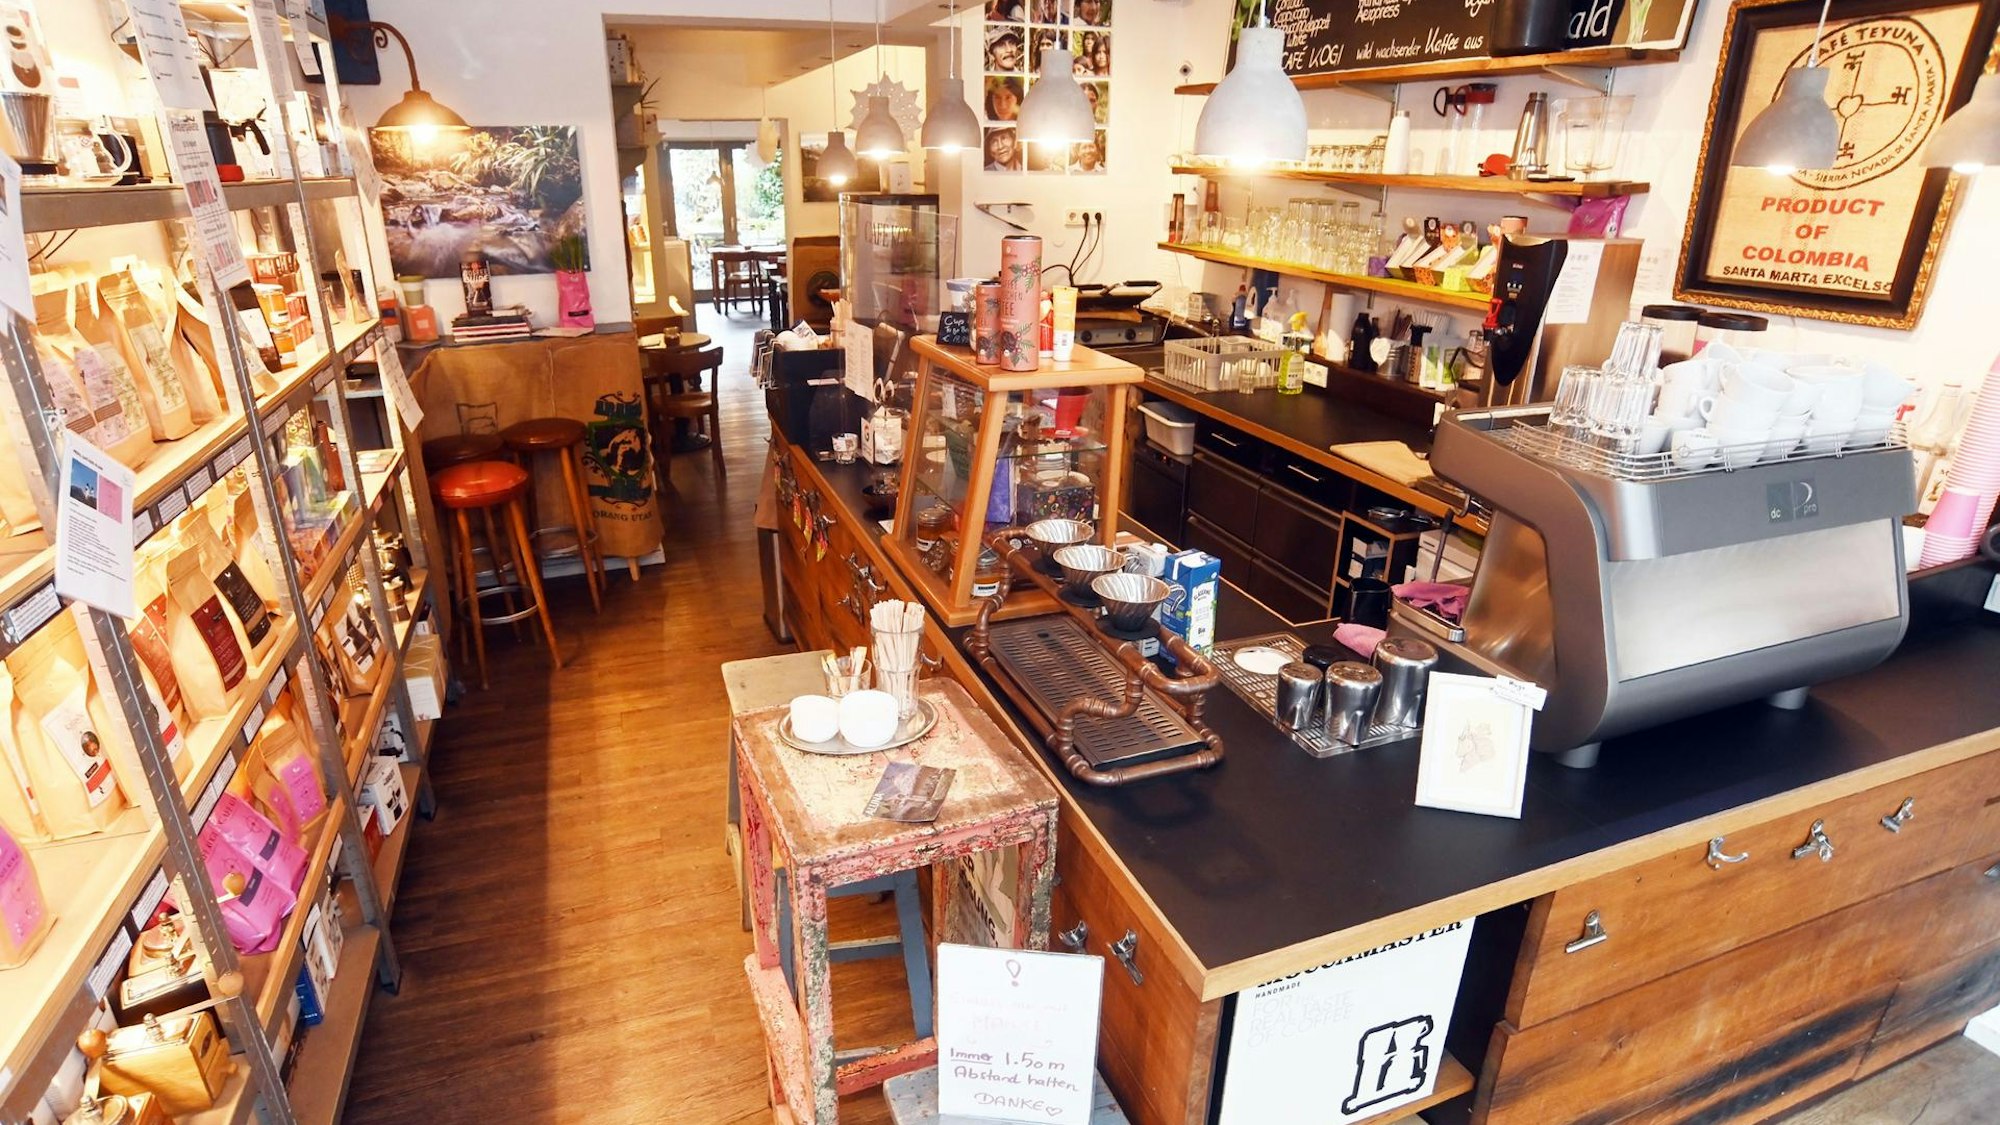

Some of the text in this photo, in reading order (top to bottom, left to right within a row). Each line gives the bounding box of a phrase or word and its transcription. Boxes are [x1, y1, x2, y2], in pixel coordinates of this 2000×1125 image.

[1354, 5, 1401, 25] Aeropress
[1282, 45, 1307, 70] CAFÉ
[1308, 44, 1345, 69] KOGI
[1376, 37, 1421, 60] wachsender
[1424, 27, 1458, 54] Kaffee
[1464, 35, 1484, 50] aus
[1855, 26, 1925, 56] TEYUNA
[1850, 154, 1895, 179] NEVADA
[1761, 197, 1885, 217] PRODUCT
[1795, 224, 1829, 240] OF
[1742, 245, 1871, 272] COLOMBIA
[1723, 265, 1766, 278] SANTA
[1769, 269, 1819, 285] MARTA
[1803, 504, 1817, 516] pro
[1254, 981, 1302, 999] HANDMADE
[954, 1065, 1079, 1093] Abstand halten
[974, 1092, 1045, 1111] DANKE
